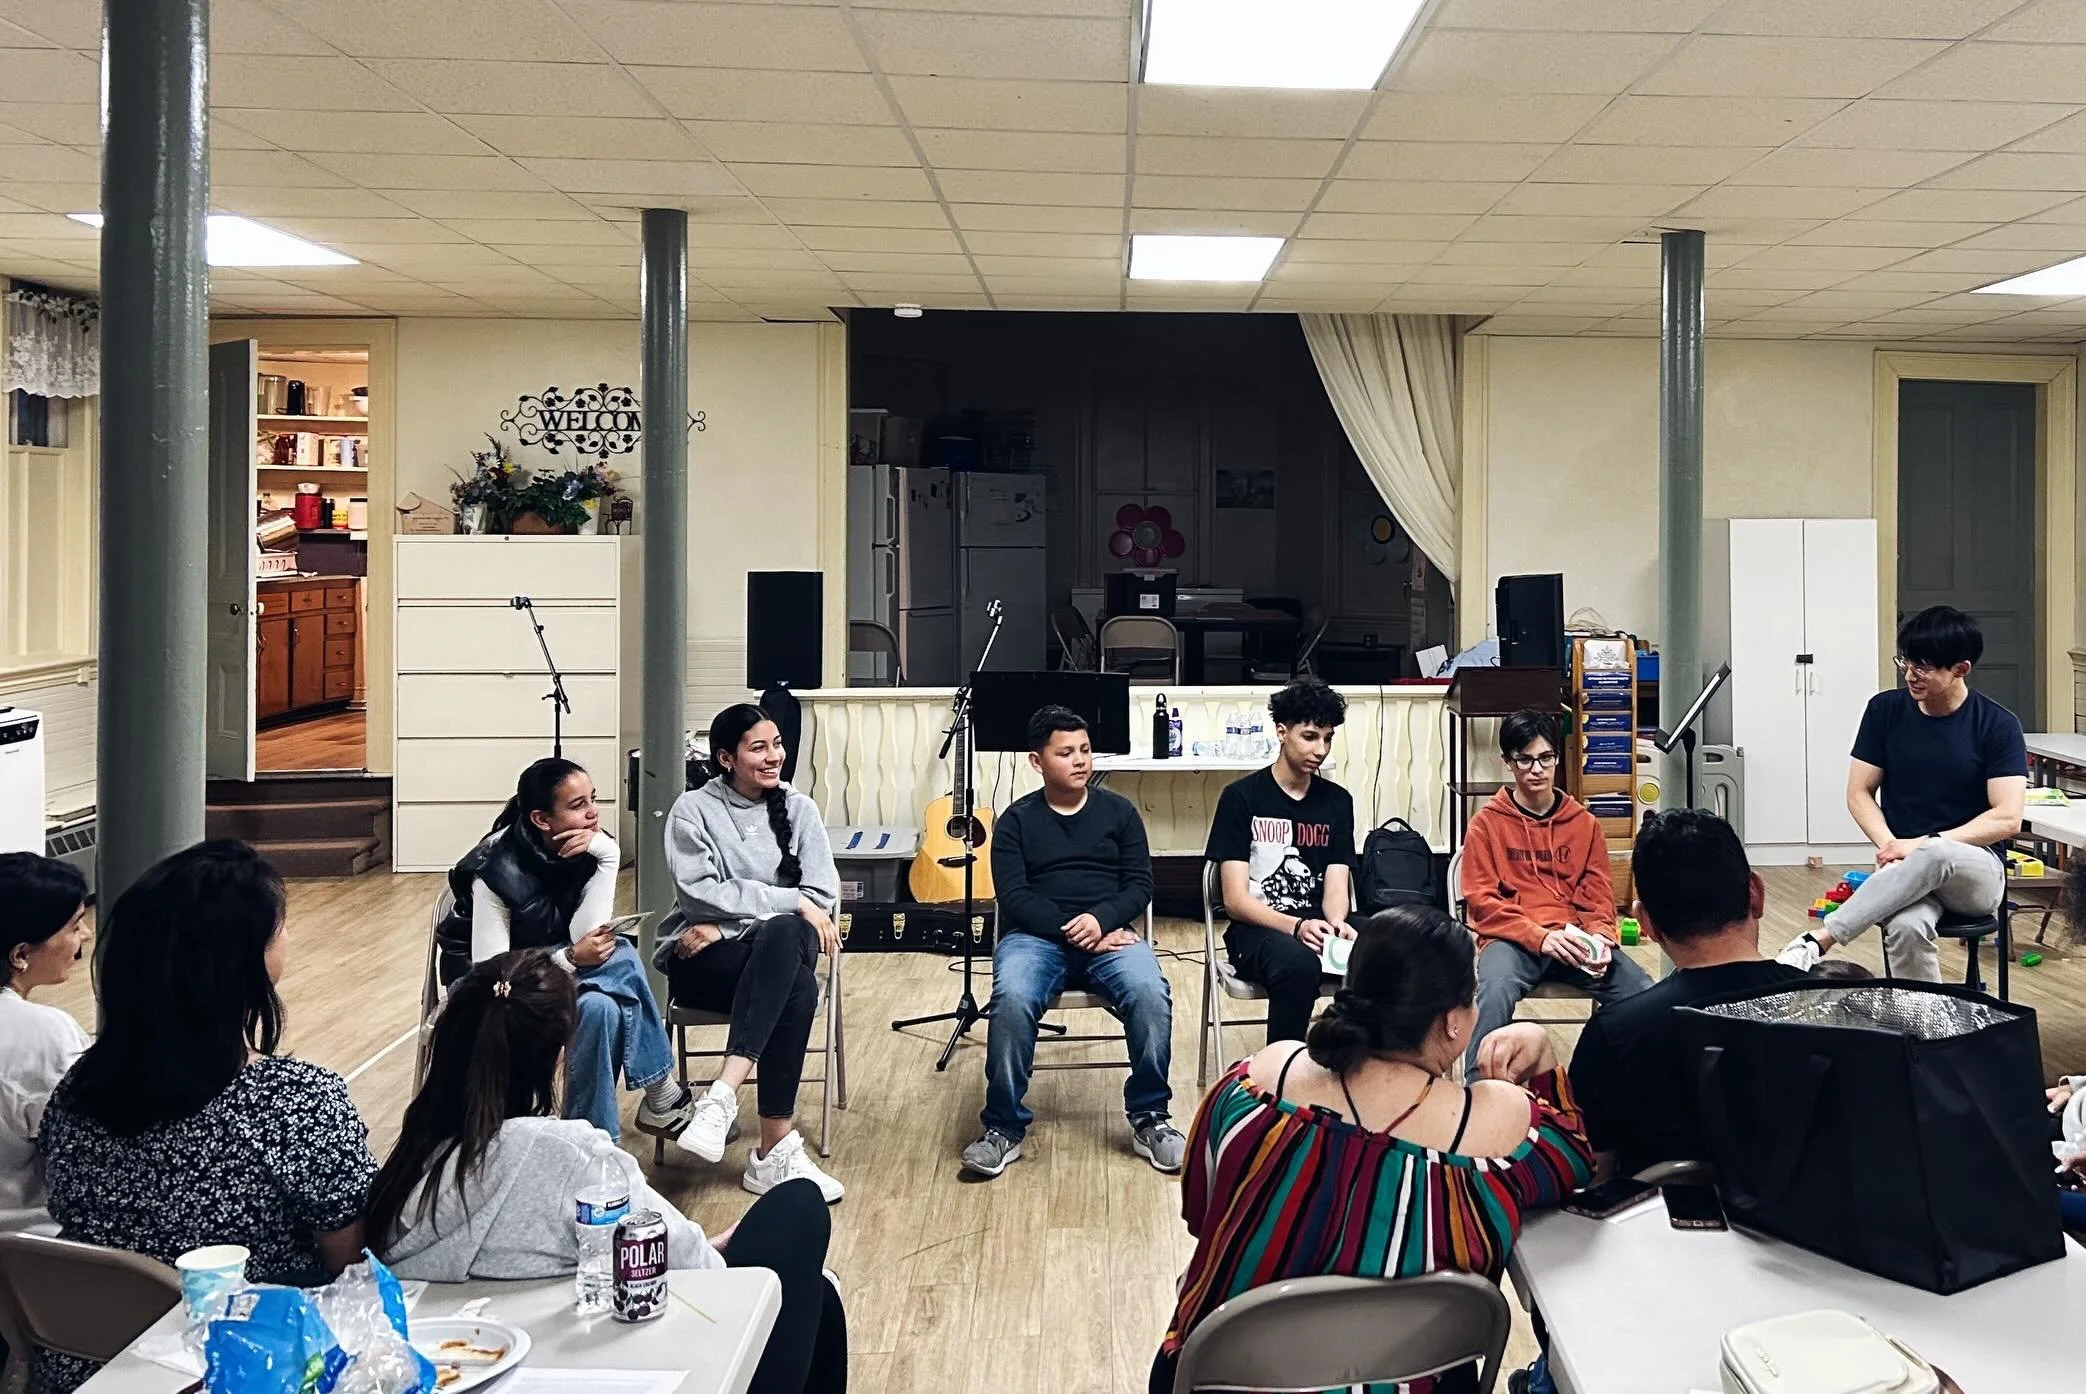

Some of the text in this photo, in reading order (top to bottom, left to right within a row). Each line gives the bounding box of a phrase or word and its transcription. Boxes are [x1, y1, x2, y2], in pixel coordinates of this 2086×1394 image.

[1253, 819, 1330, 847] SNOOP DOGG
[620, 1241, 664, 1270] POLAR
[630, 1267, 657, 1278] SELTZER
